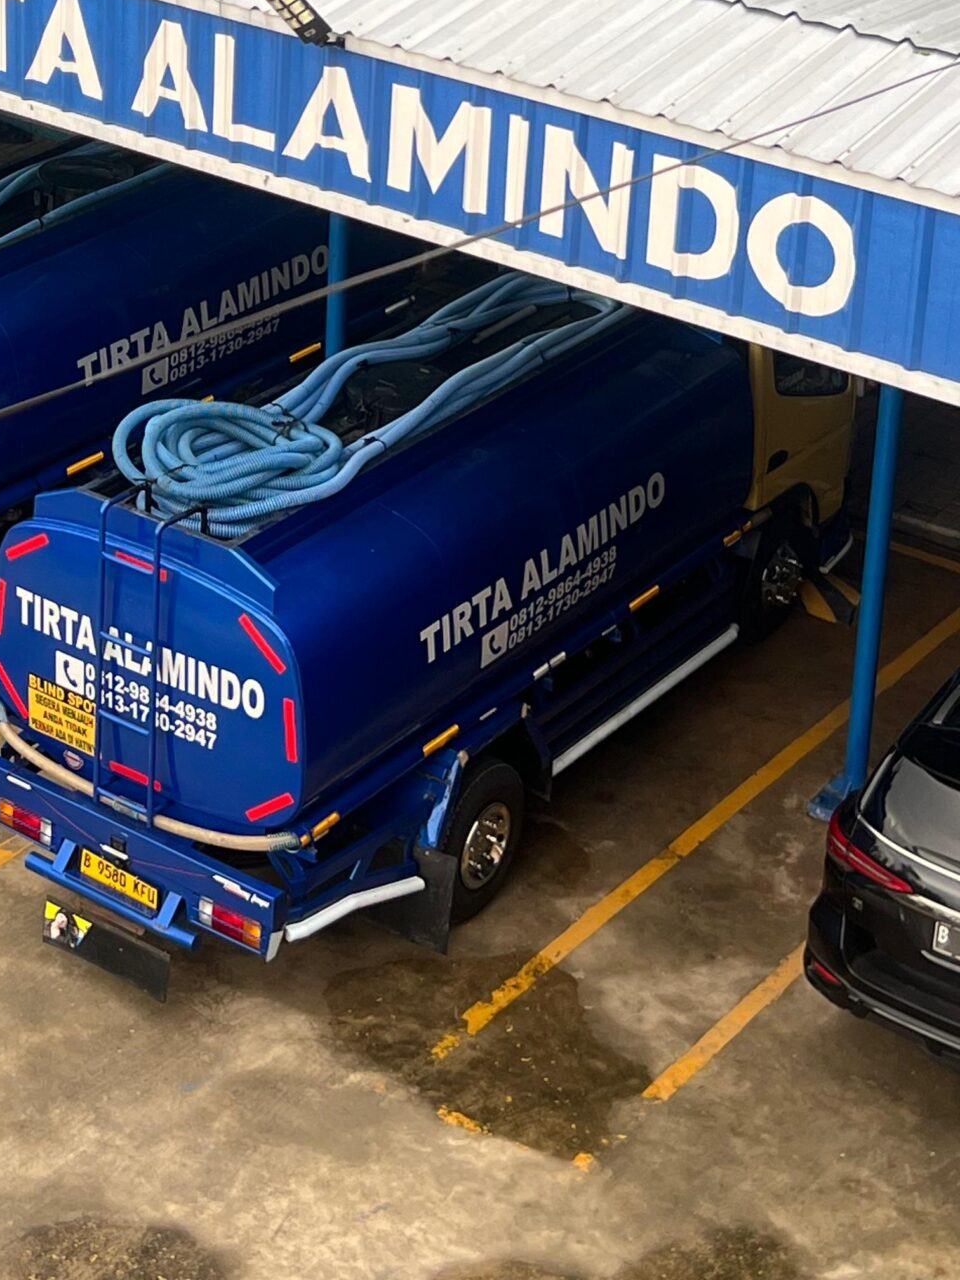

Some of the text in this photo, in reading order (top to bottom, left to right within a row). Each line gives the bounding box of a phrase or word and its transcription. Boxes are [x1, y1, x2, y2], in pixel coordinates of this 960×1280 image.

[131, 19, 856, 317] ALAMINDO
[77, 244, 330, 387] TIRTA ALAMINDO
[169, 318, 280, 383] 0813-1730-2947
[420, 471, 666, 664] TIRTA ALAMINDO
[507, 563, 617, 650] 0813-1730-2947
[509, 545, 617, 631] 0812-9864-4938
[15, 586, 266, 720] TIRTA ALAMINDO
[29, 673, 65, 701] BLIND
[65, 719, 89, 738] TIDAK
[84, 852, 92, 869] B
[98, 860, 127, 888] 9580
[133, 879, 155, 904] KFU
[937, 925, 949, 944] B
